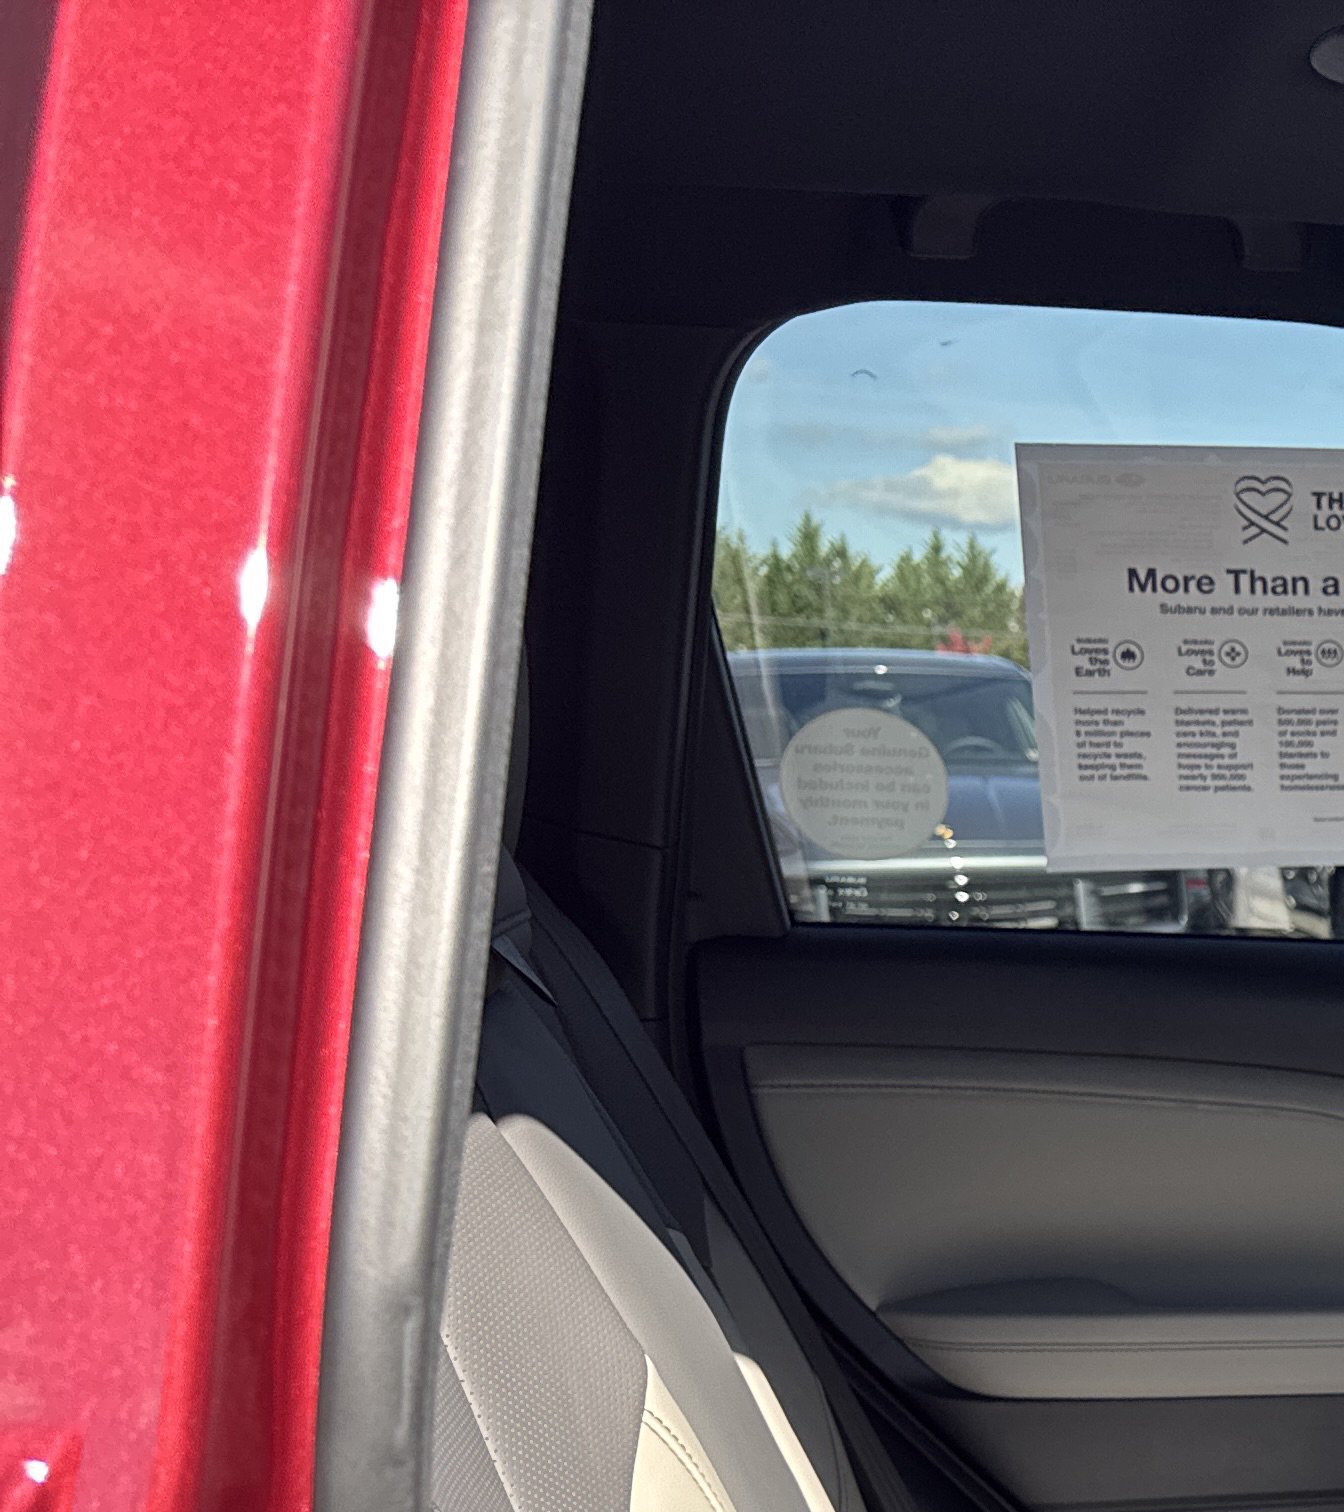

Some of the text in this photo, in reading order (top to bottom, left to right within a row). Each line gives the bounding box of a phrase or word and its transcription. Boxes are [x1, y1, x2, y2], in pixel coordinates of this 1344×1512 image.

[1127, 568, 1215, 596] More
[1227, 569, 1309, 597] Than
[1321, 575, 1340, 597] a
[1159, 603, 1207, 617] Subaru
[1211, 604, 1234, 617] and
[1238, 606, 1260, 618] our
[1262, 605, 1314, 619] retailers
[1072, 646, 1109, 656] Loves
[1178, 647, 1214, 656] Loves
[1277, 648, 1312, 657] Loves
[1088, 657, 1109, 666] the
[1202, 658, 1215, 667] to
[1301, 658, 1312, 666] to
[1075, 668, 1110, 677] Earth
[1186, 667, 1215, 677] Care
[1287, 667, 1312, 678] Help
[1074, 708, 1145, 717] Helped recycle
[1277, 707, 1317, 715] Donated
[1221, 719, 1253, 728] patient
[1316, 719, 1338, 727] pairs
[1120, 731, 1151, 739] pieces
[1222, 730, 1239, 738] and
[1176, 742, 1236, 750] encouraging
[1177, 753, 1224, 761] messages
[1178, 763, 1201, 771] hope
[1217, 764, 1253, 772] support
[1179, 774, 1207, 782] nearly
[1280, 773, 1339, 782] experiencing
[1214, 784, 1252, 793] patients.
